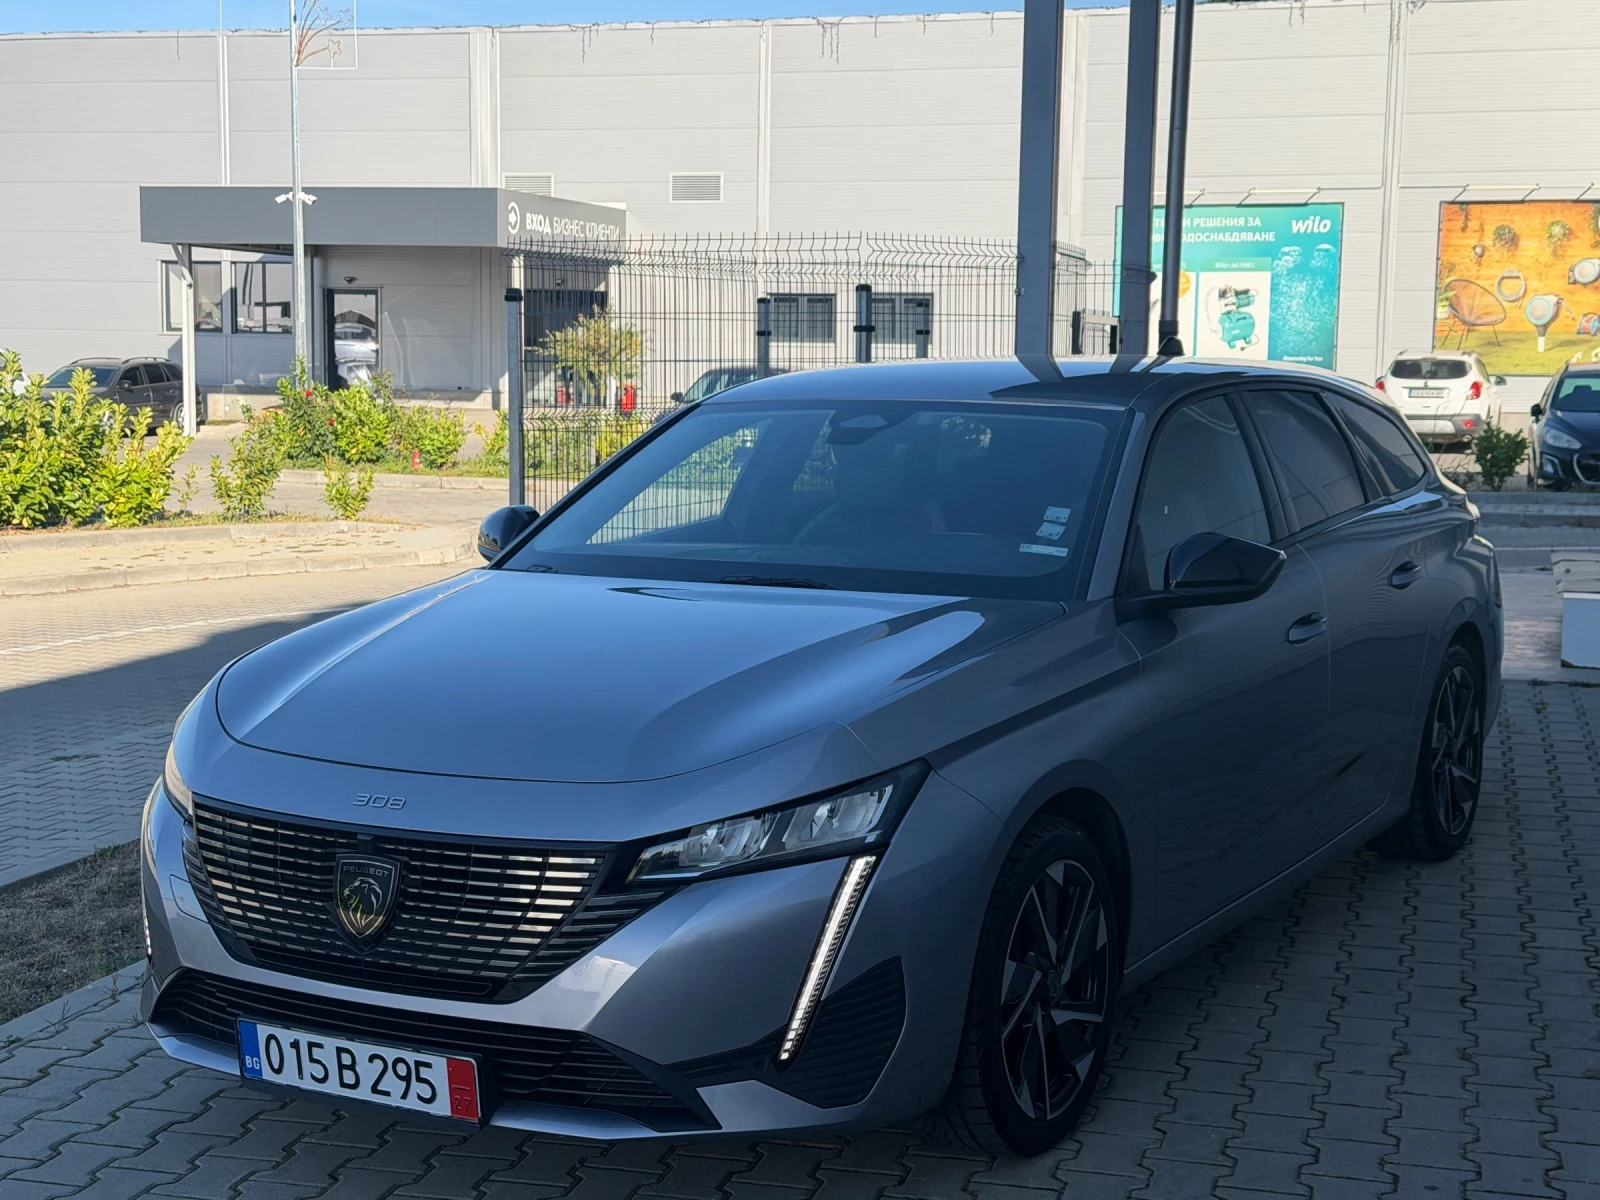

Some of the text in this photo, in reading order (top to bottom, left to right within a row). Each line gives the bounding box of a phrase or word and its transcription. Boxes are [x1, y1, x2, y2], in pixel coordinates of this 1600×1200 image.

[525, 212, 620, 241] ВХОД БИЗНЕС КЛИЕНТИ
[1193, 216, 1245, 227] РЕШЕНИЯ
[1247, 216, 1262, 227] ЗА
[1291, 215, 1332, 234] wilo
[1181, 231, 1276, 243] ОДОСНАБДЯВАНЕ
[352, 793, 406, 809] 308
[343, 865, 390, 877] PEUGEOT
[245, 1055, 261, 1070] BG
[454, 1095, 471, 1113] 27
